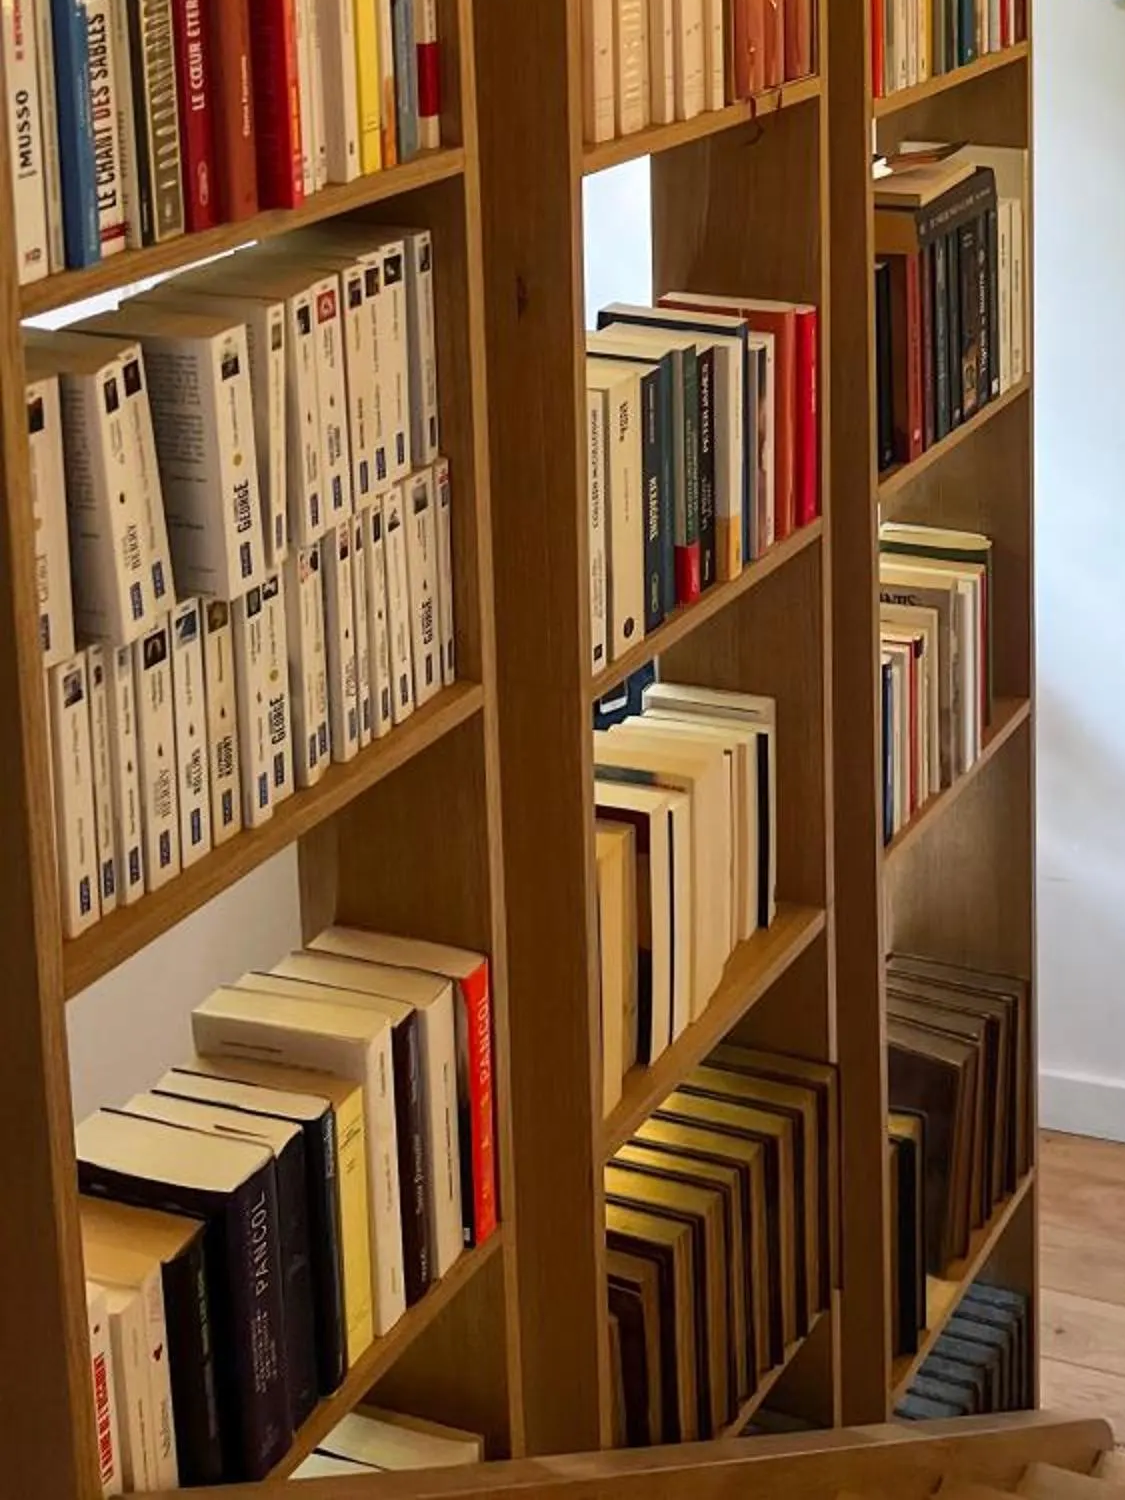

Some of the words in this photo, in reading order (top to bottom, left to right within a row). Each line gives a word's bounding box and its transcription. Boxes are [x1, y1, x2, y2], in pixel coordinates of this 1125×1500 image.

[89, 12, 109, 80] SABLES
[15, 89, 33, 169] MUSSO
[91, 84, 112, 120] DES
[191, 93, 206, 111] LE
[95, 125, 115, 186] CHANT
[97, 188, 117, 211] LE
[235, 479, 251, 533] GEORGE
[127, 523, 142, 571] BERRY
[271, 693, 286, 745] GEORGE
[477, 989, 490, 1083] PANCOL
[250, 1189, 269, 1295] PANCOL
